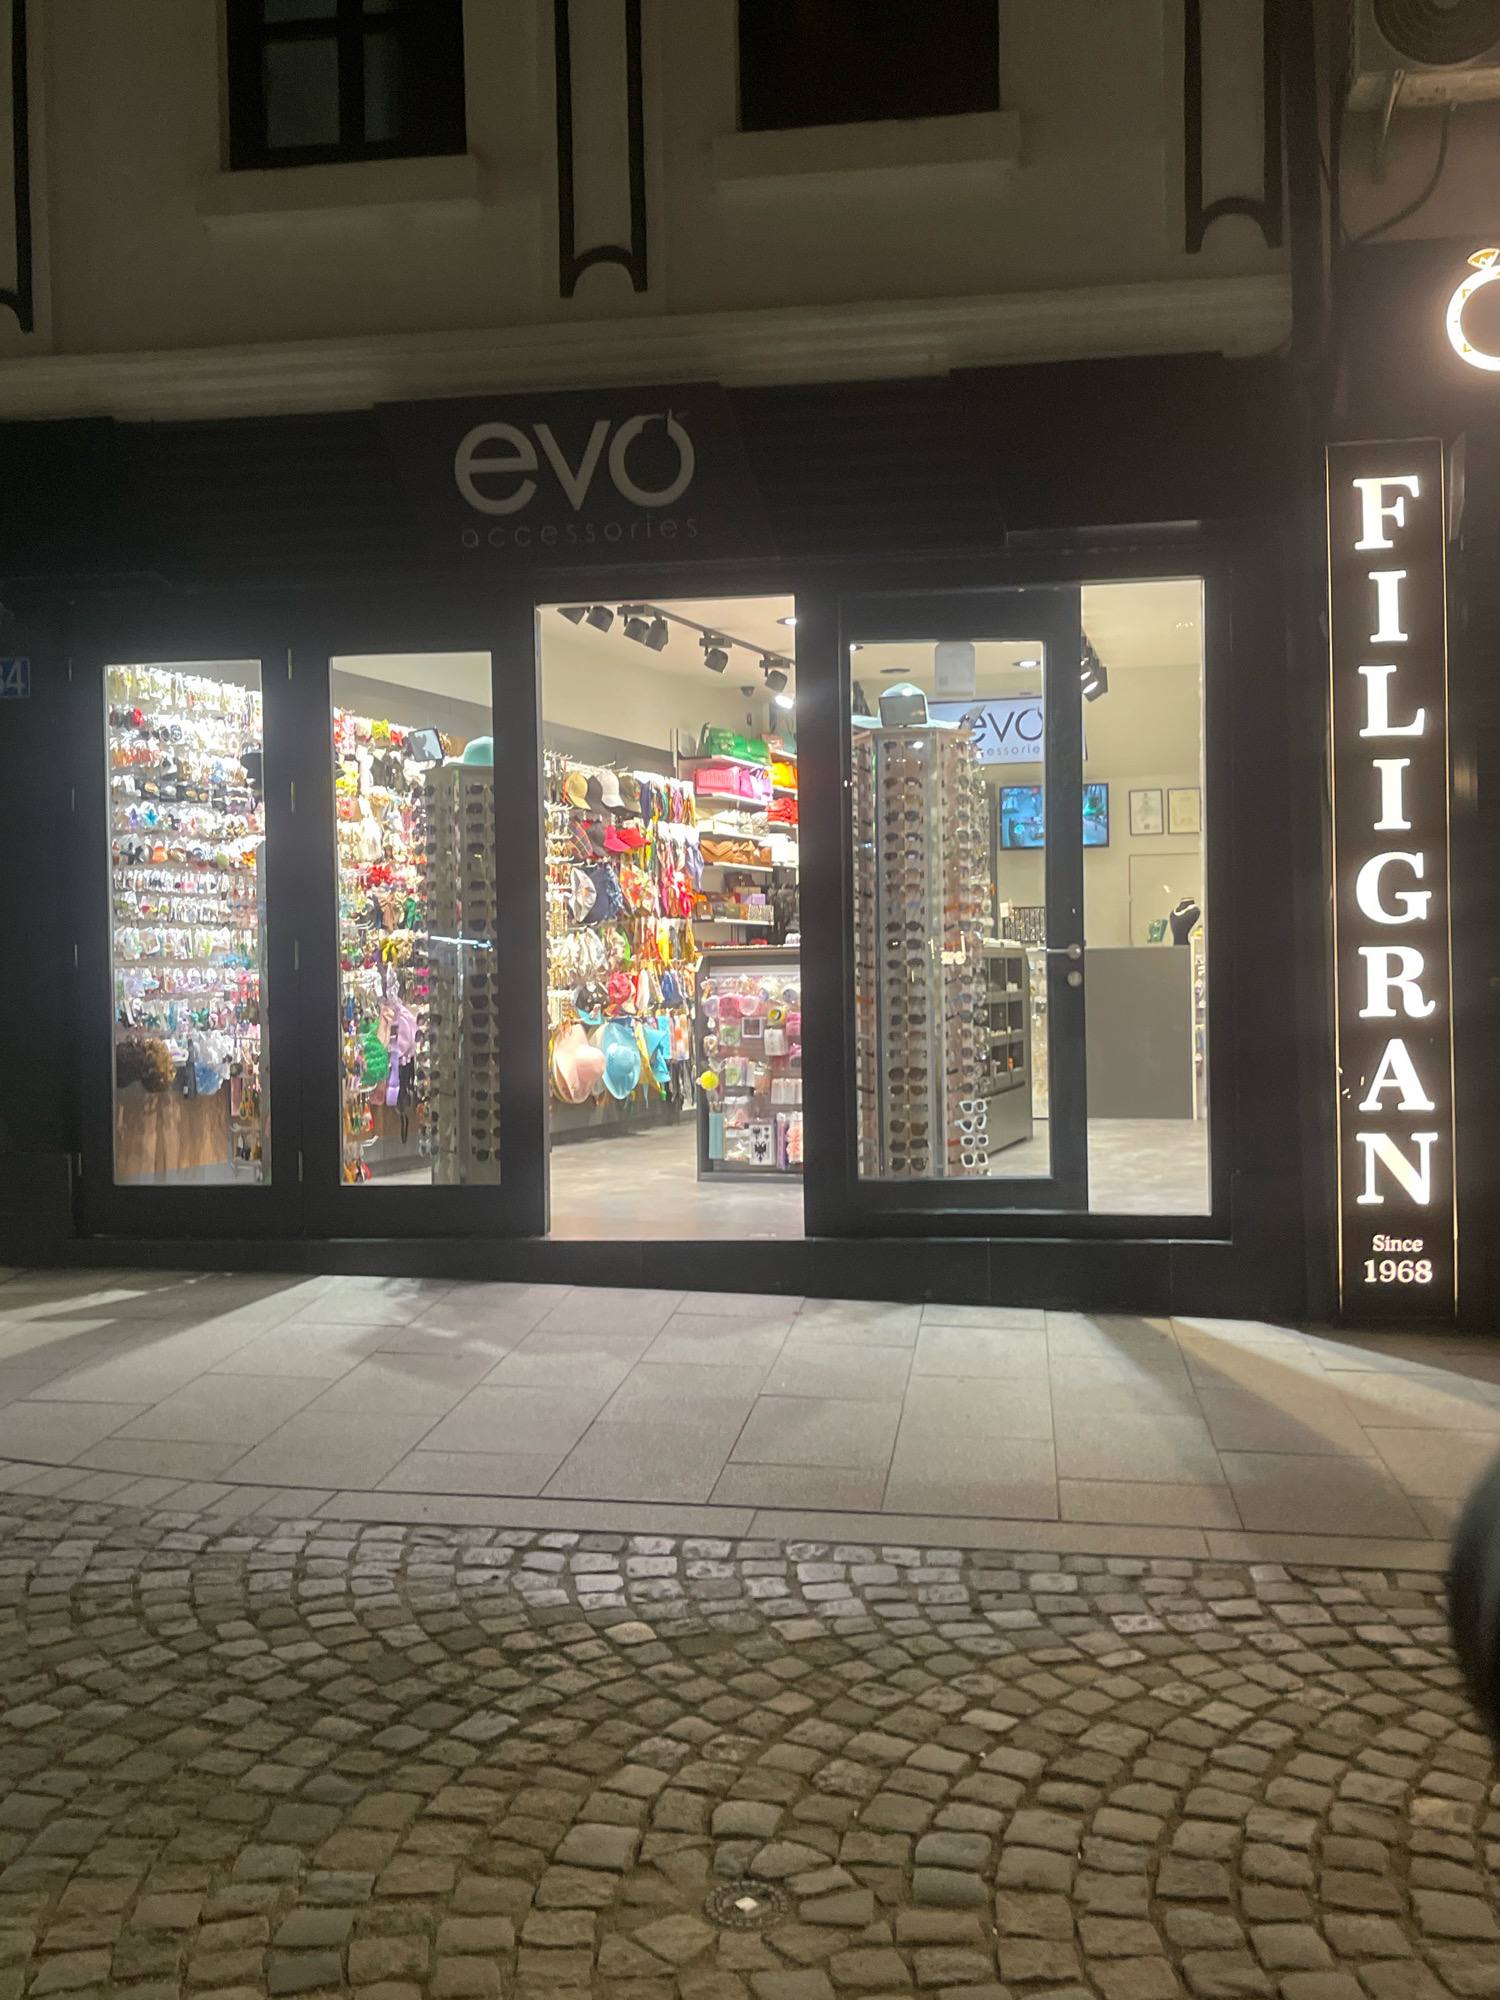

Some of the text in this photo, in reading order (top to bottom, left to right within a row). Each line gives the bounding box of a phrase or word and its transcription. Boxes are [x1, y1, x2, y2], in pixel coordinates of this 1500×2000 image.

[454, 410, 695, 516] evo
[461, 515, 698, 549] accessories
[0, 660, 25, 695] 4
[1352, 475, 1438, 1205] FILIGRAN
[1372, 1234, 1424, 1252] Since
[1364, 1259, 1433, 1283] 1968
